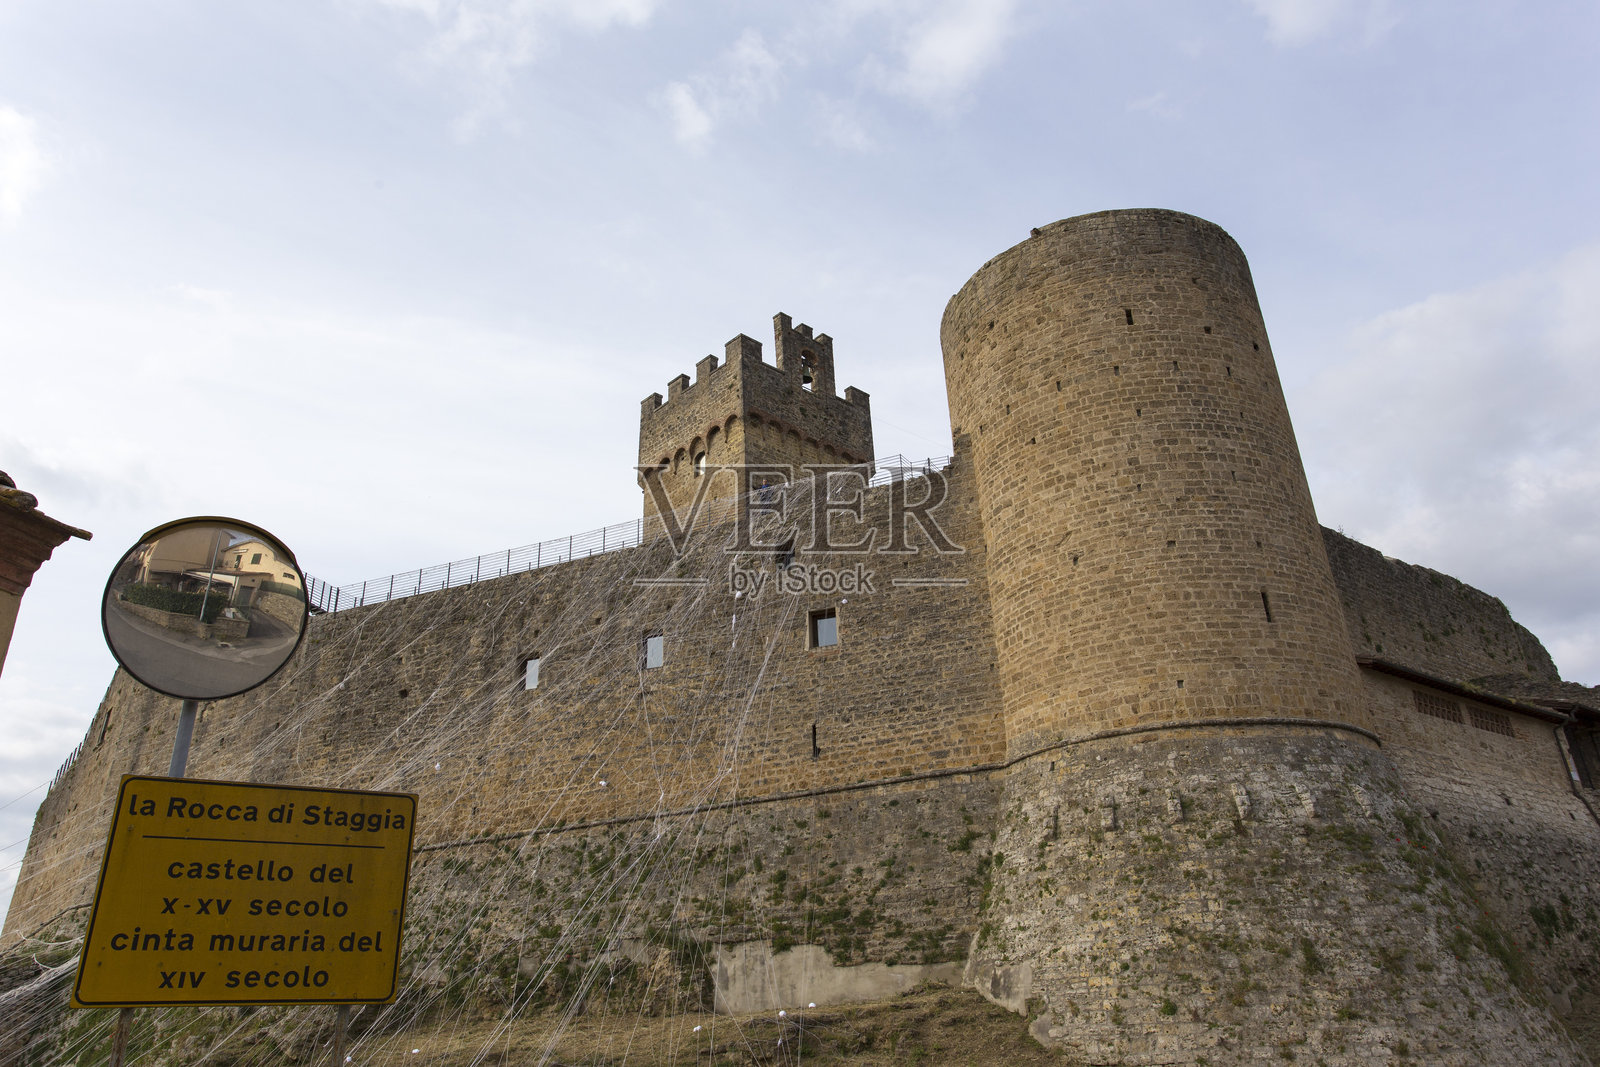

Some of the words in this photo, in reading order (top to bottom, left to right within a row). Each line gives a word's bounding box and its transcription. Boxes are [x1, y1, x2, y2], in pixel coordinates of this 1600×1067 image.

[128, 793, 156, 817] la
[166, 796, 258, 822] Rocca
[267, 801, 295, 824] di
[301, 804, 406, 833] Staggia
[167, 858, 294, 883] castello
[309, 863, 354, 885] del
[247, 895, 349, 918] secolo
[110, 926, 195, 952] cinta
[208, 929, 326, 953] muraria
[338, 930, 383, 953] del
[224, 965, 329, 989] secolo
